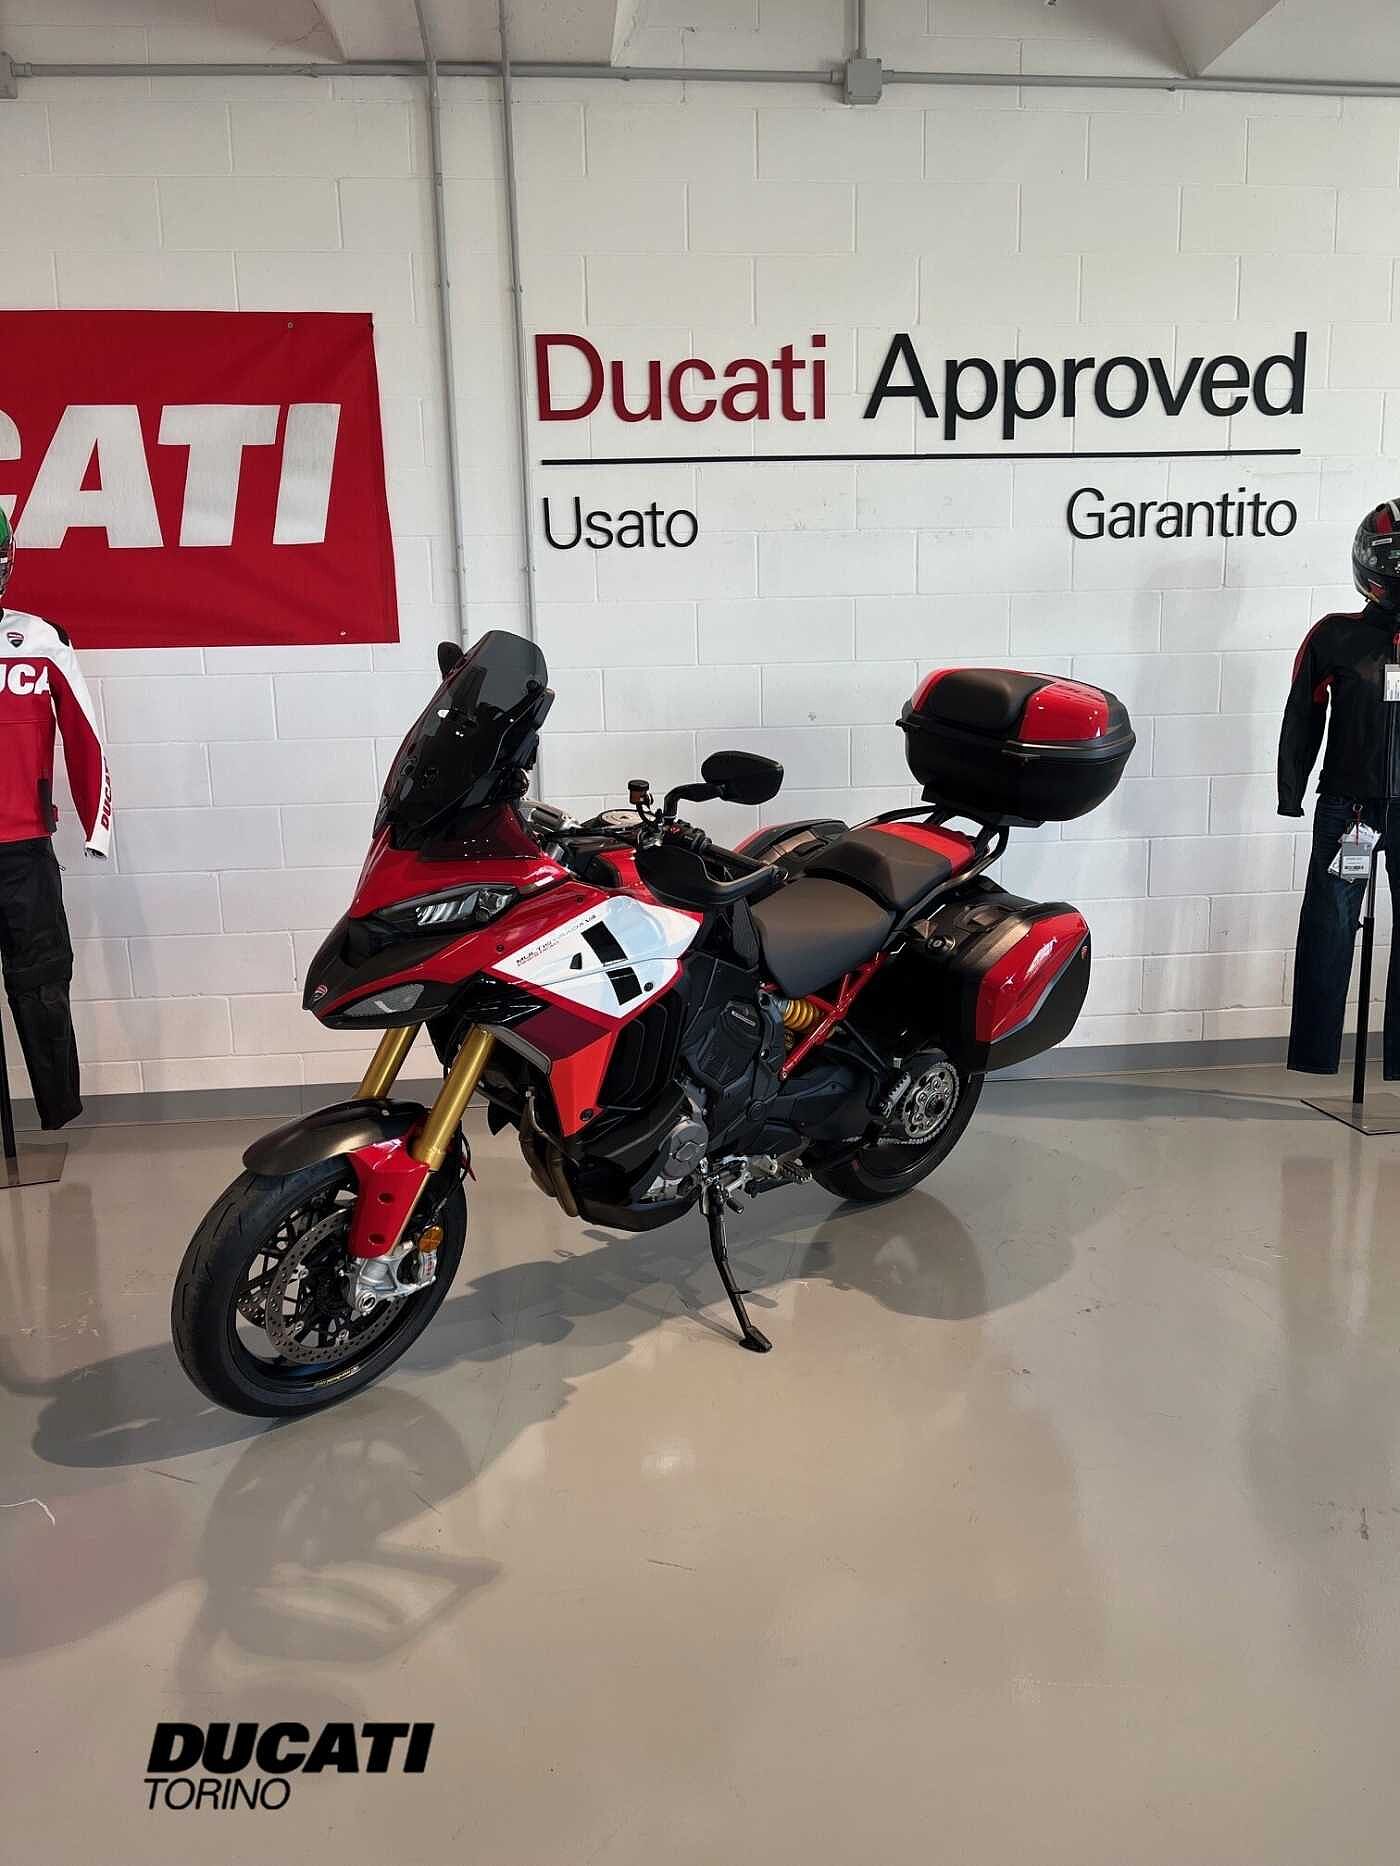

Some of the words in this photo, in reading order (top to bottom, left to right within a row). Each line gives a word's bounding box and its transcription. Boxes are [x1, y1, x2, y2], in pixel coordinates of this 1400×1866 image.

[536, 333, 826, 421] Ducati
[863, 332, 1306, 440] Approved
[0, 403, 341, 548] ATI
[543, 496, 699, 550] Usato
[1066, 486, 1297, 540] Garantito
